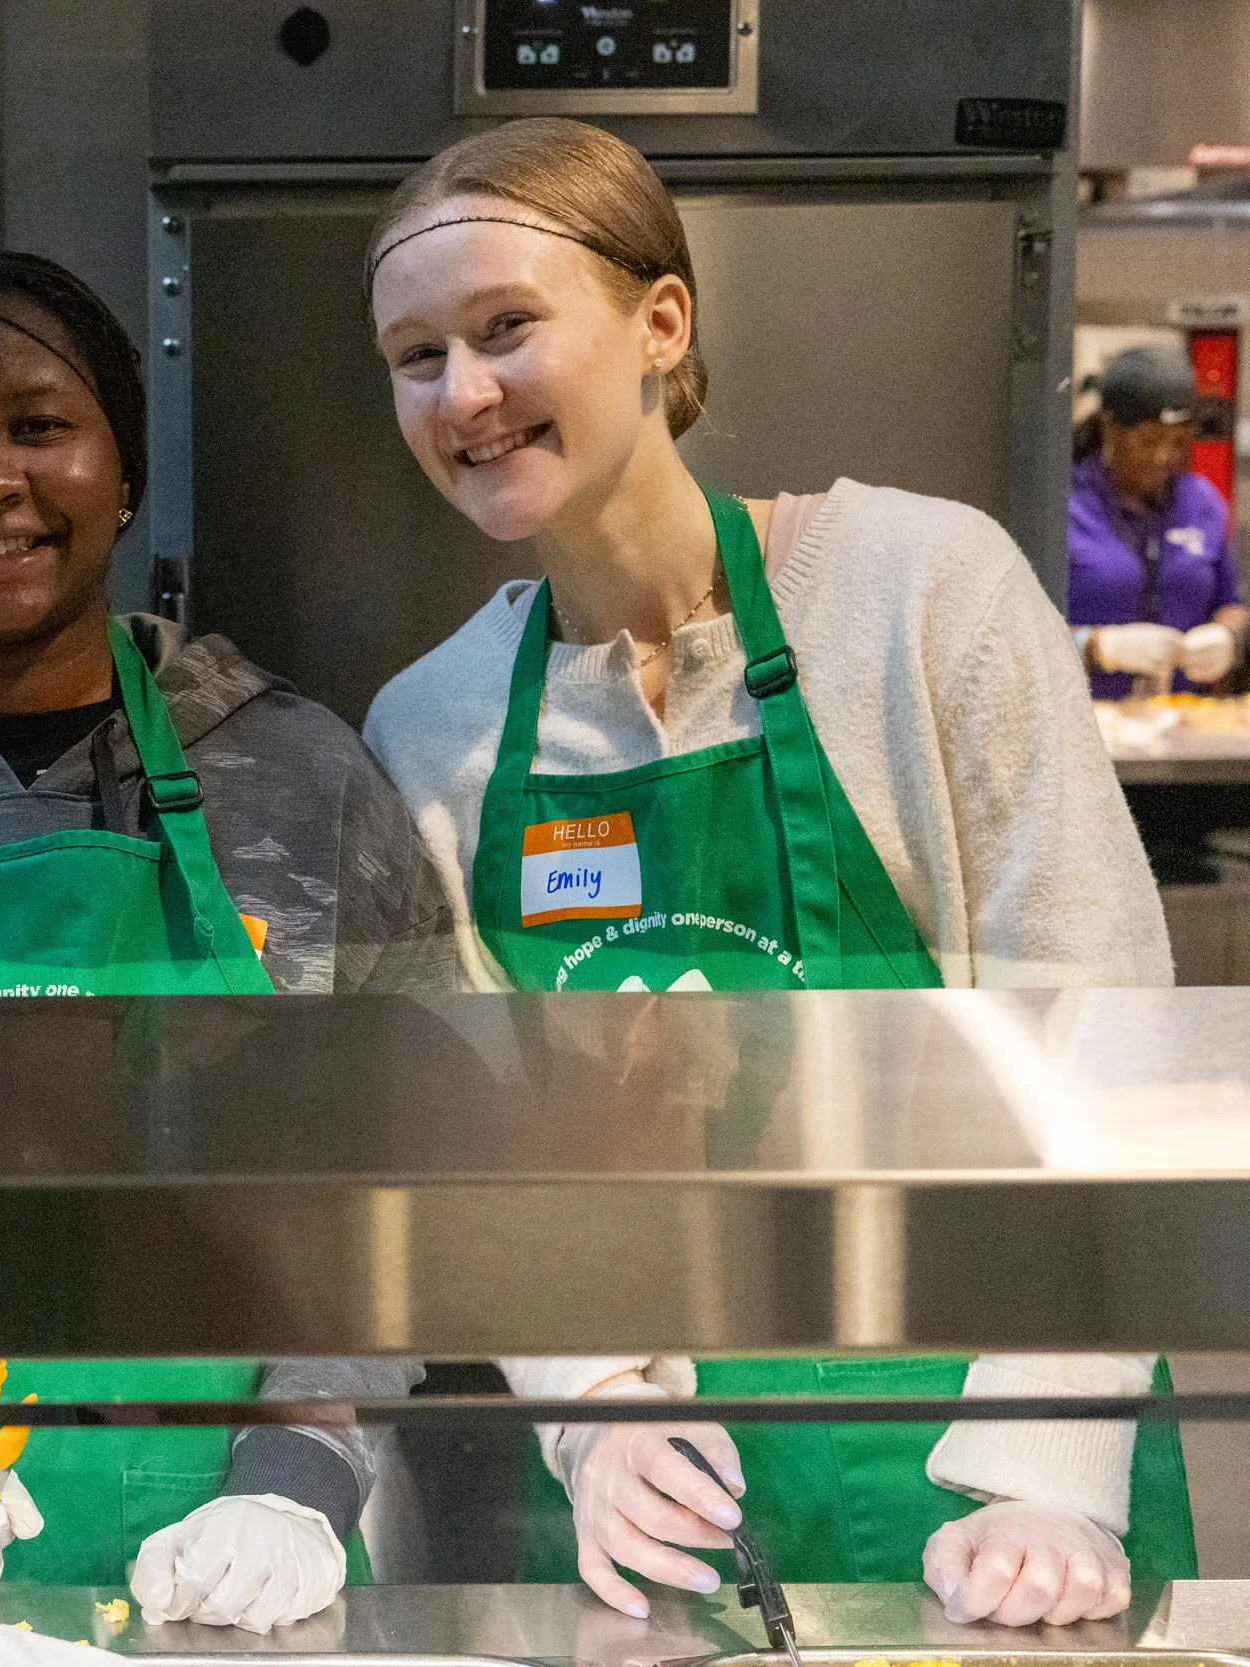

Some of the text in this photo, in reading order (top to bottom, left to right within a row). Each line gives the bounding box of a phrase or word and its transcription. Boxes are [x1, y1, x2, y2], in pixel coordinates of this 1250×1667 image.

[553, 821, 610, 841] HELLO
[547, 868, 602, 899] Emily
[563, 935, 603, 970] hope
[605, 926, 619, 942] &
[622, 911, 667, 935] dignity
[757, 936, 779, 956] at
[777, 950, 792, 966] a
[45, 984, 80, 998] one
